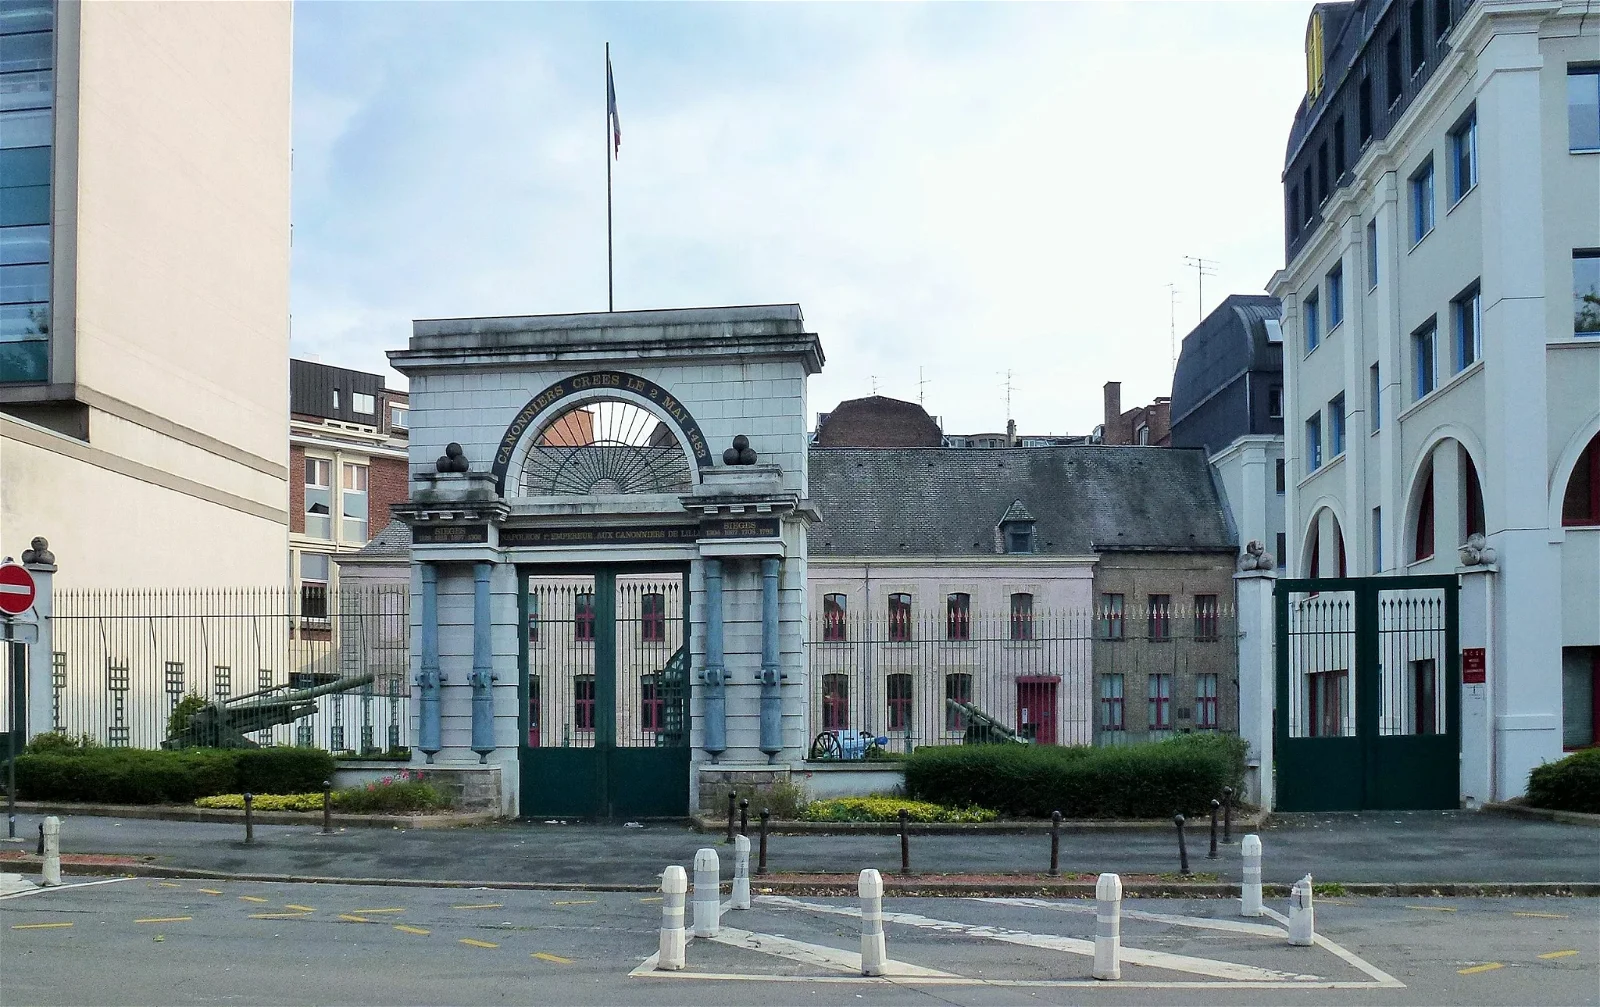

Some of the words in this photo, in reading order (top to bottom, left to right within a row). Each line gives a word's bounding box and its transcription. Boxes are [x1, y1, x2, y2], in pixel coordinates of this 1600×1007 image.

[497, 384, 564, 465] CANONNIERS
[572, 374, 620, 389] CREES
[626, 377, 646, 392] LE
[649, 387, 658, 399] 2
[661, 395, 689, 424] MAI
[687, 427, 707, 458] 1483
[723, 521, 757, 530] SIEGES
[434, 527, 467, 535] SIEGES
[500, 533, 541, 541] NAPOLEON
[597, 532, 614, 540] AUX
[615, 530, 665, 539] CANONNIERS
[667, 530, 679, 538] DE
